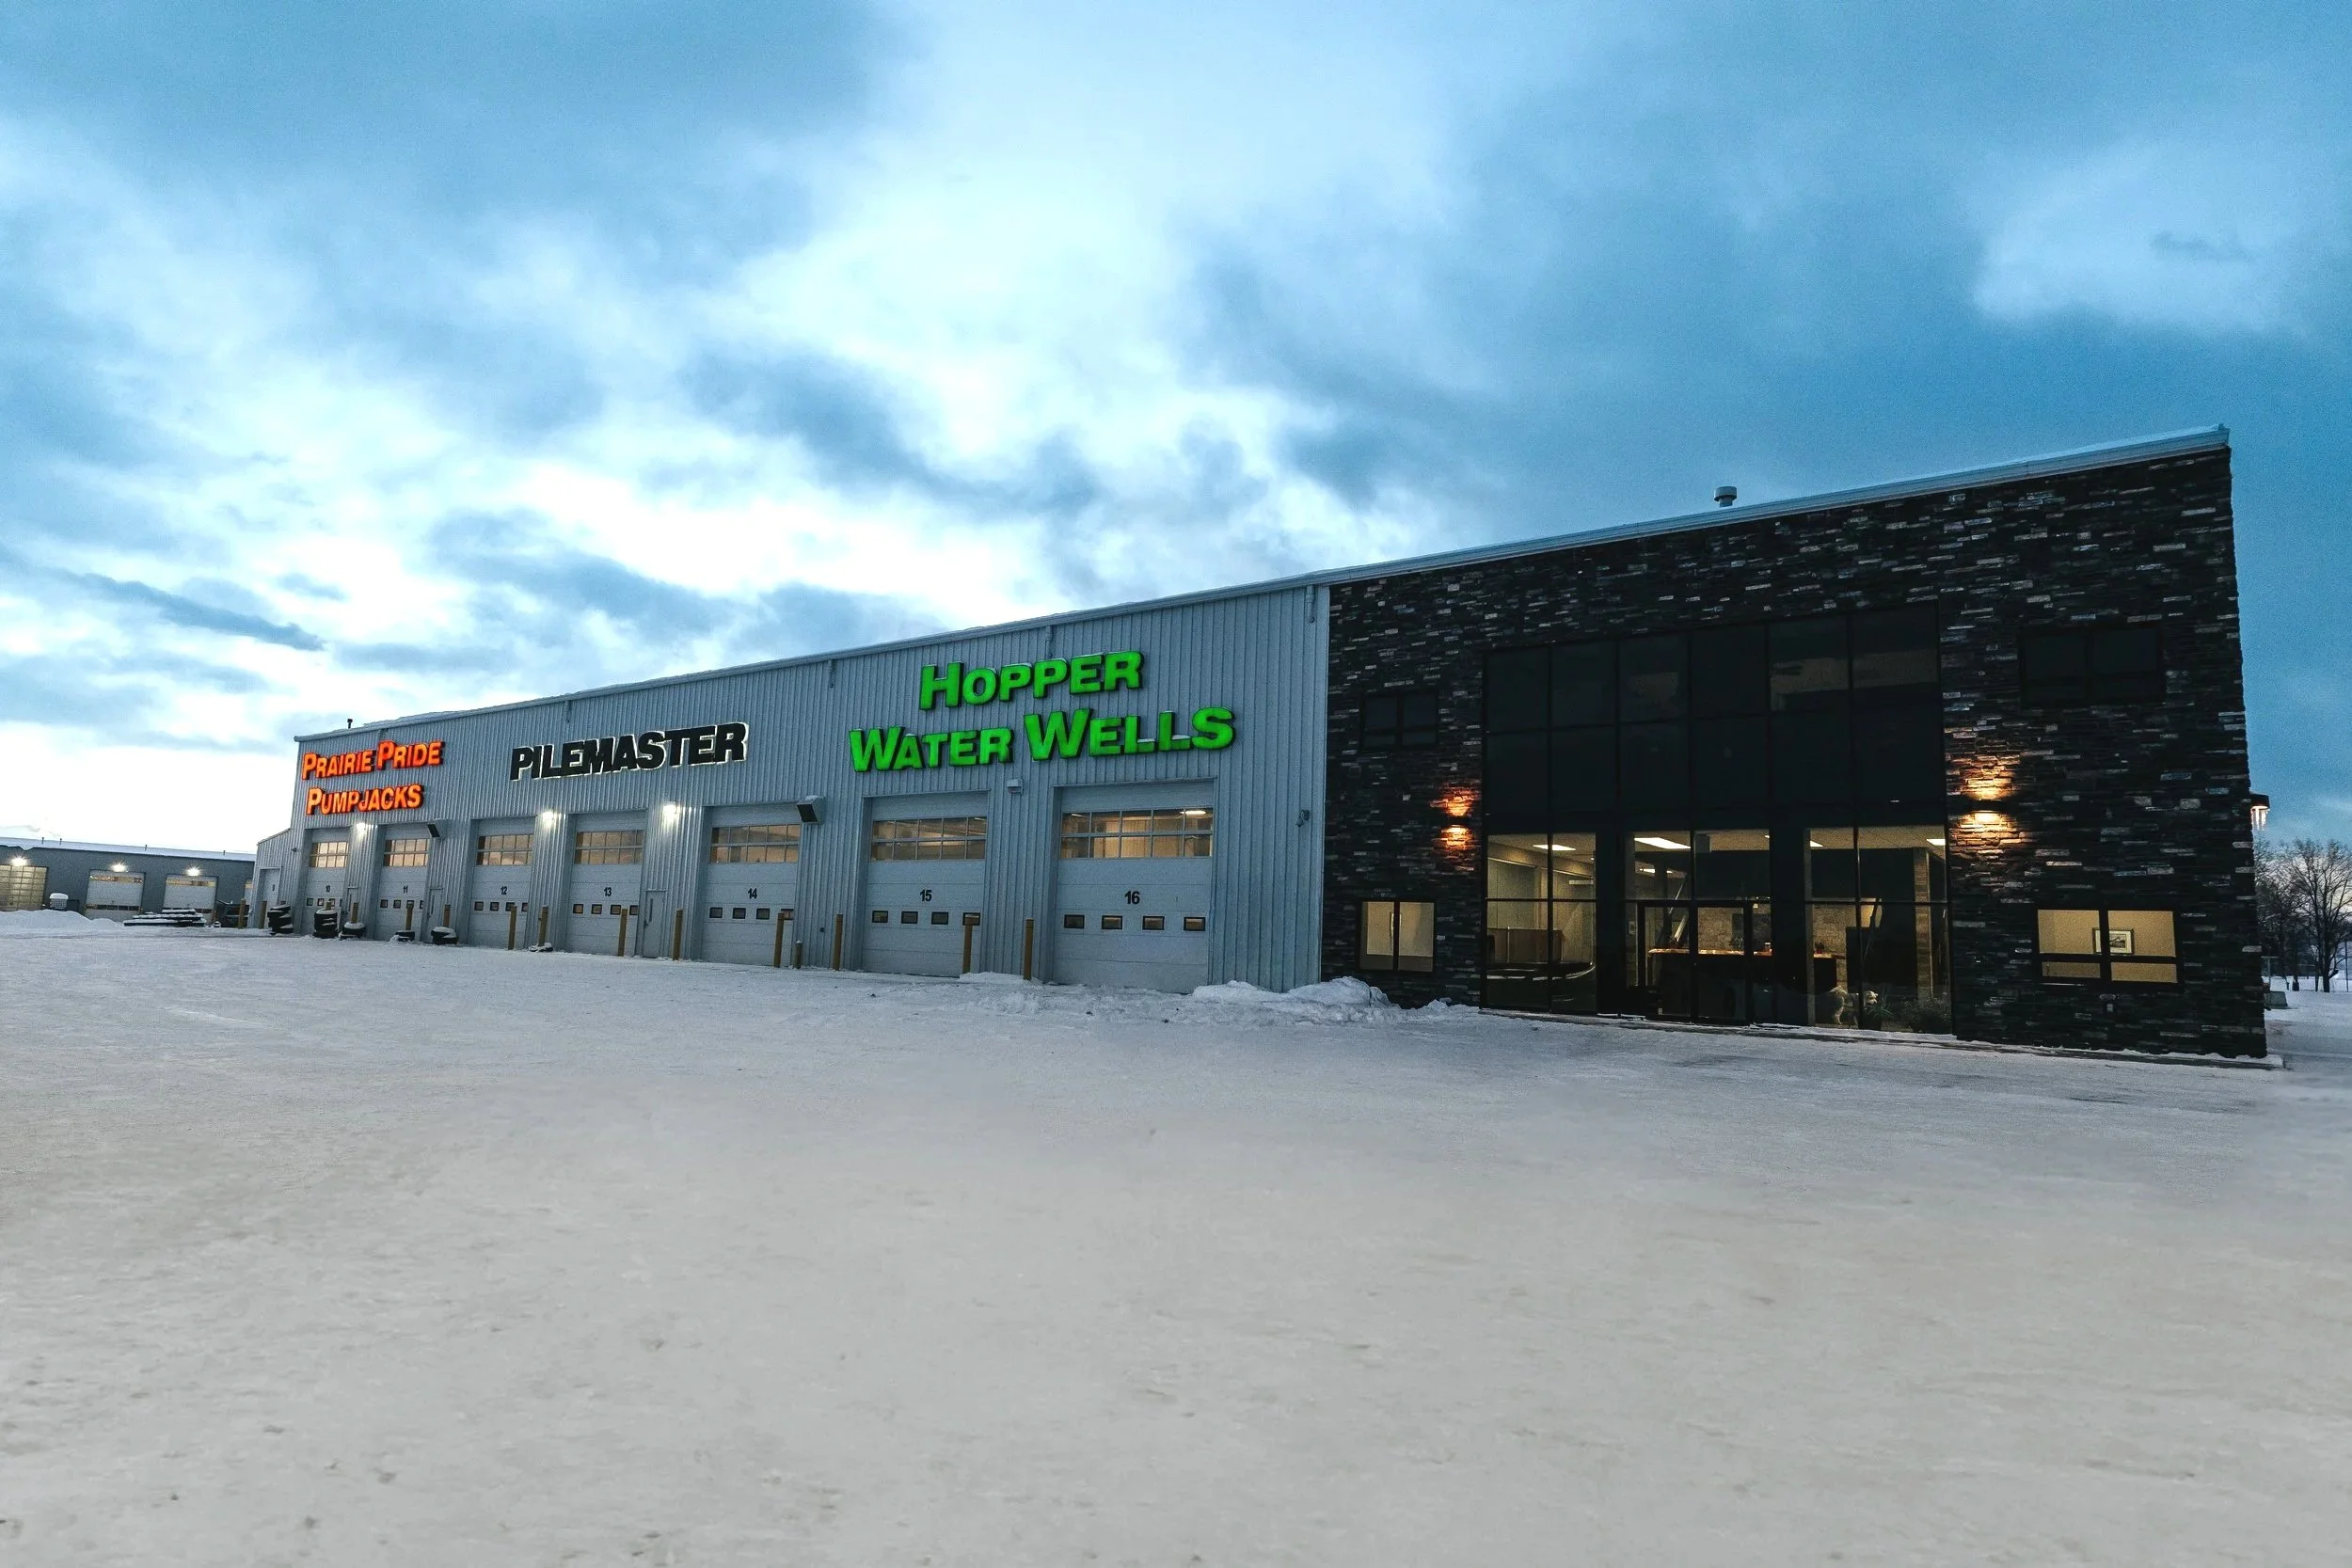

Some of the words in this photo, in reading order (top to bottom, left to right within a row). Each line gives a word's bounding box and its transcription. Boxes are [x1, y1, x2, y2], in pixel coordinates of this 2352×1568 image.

[918, 651, 1144, 711] HOPPER
[849, 726, 1014, 772] WATER
[1024, 707, 1236, 762] WELLS
[510, 721, 749, 782] PILEMASTER
[302, 751, 375, 780] PRAIRIE
[376, 740, 444, 769] PRIDE
[306, 783, 423, 816] PUMPJACKS
[403, 885, 408, 894] 11
[501, 886, 508, 895] 12
[604, 887, 612, 896] 13
[747, 888, 758, 899] 14
[920, 889, 932, 902] 15
[1125, 891, 1140, 904] 16
